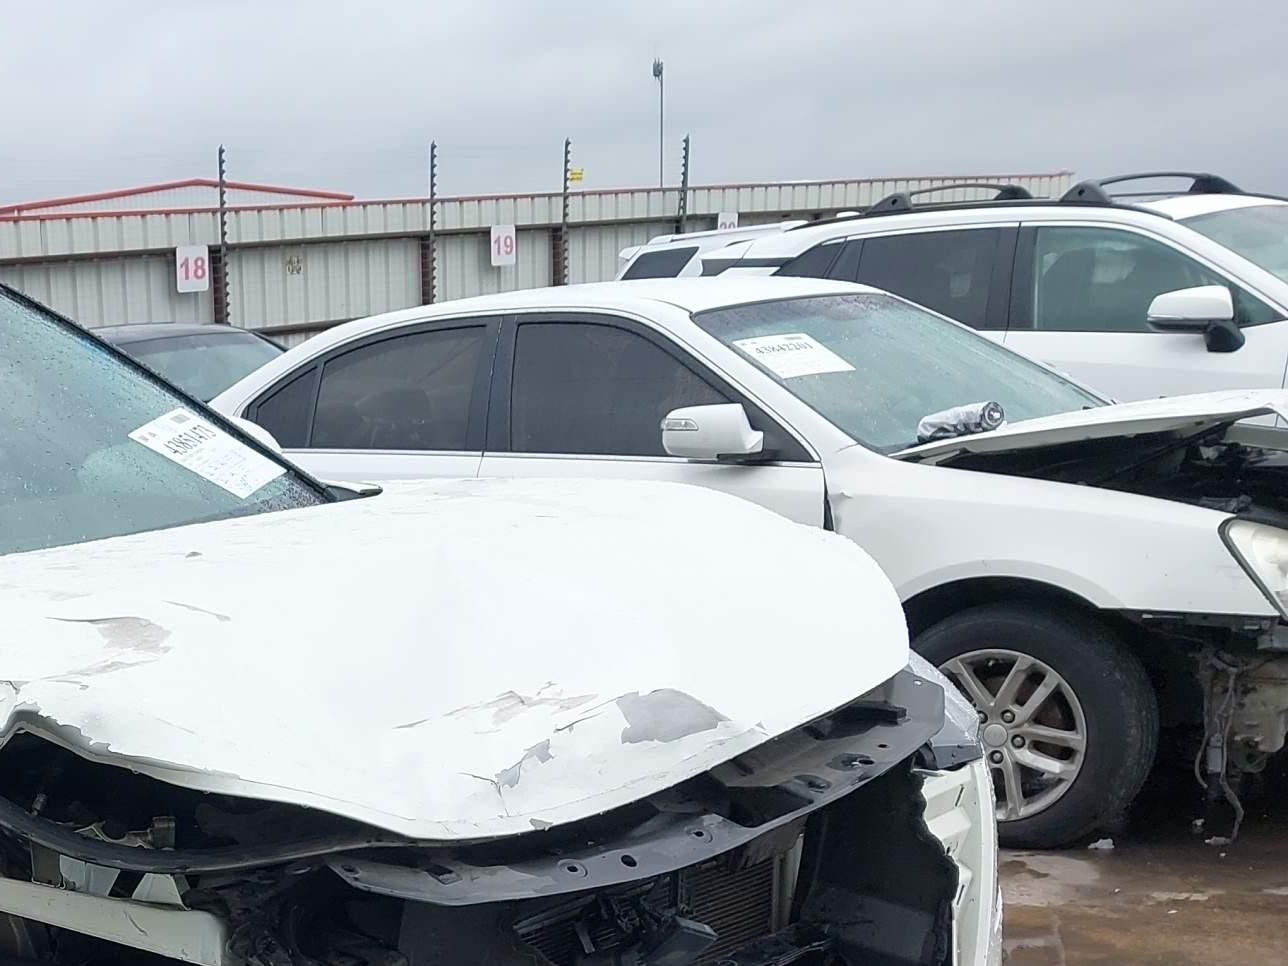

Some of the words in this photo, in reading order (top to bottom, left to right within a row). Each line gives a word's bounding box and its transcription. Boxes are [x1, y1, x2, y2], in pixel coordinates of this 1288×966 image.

[494, 235, 514, 256] 19
[180, 256, 206, 280] 18
[163, 424, 216, 456] 43851473
